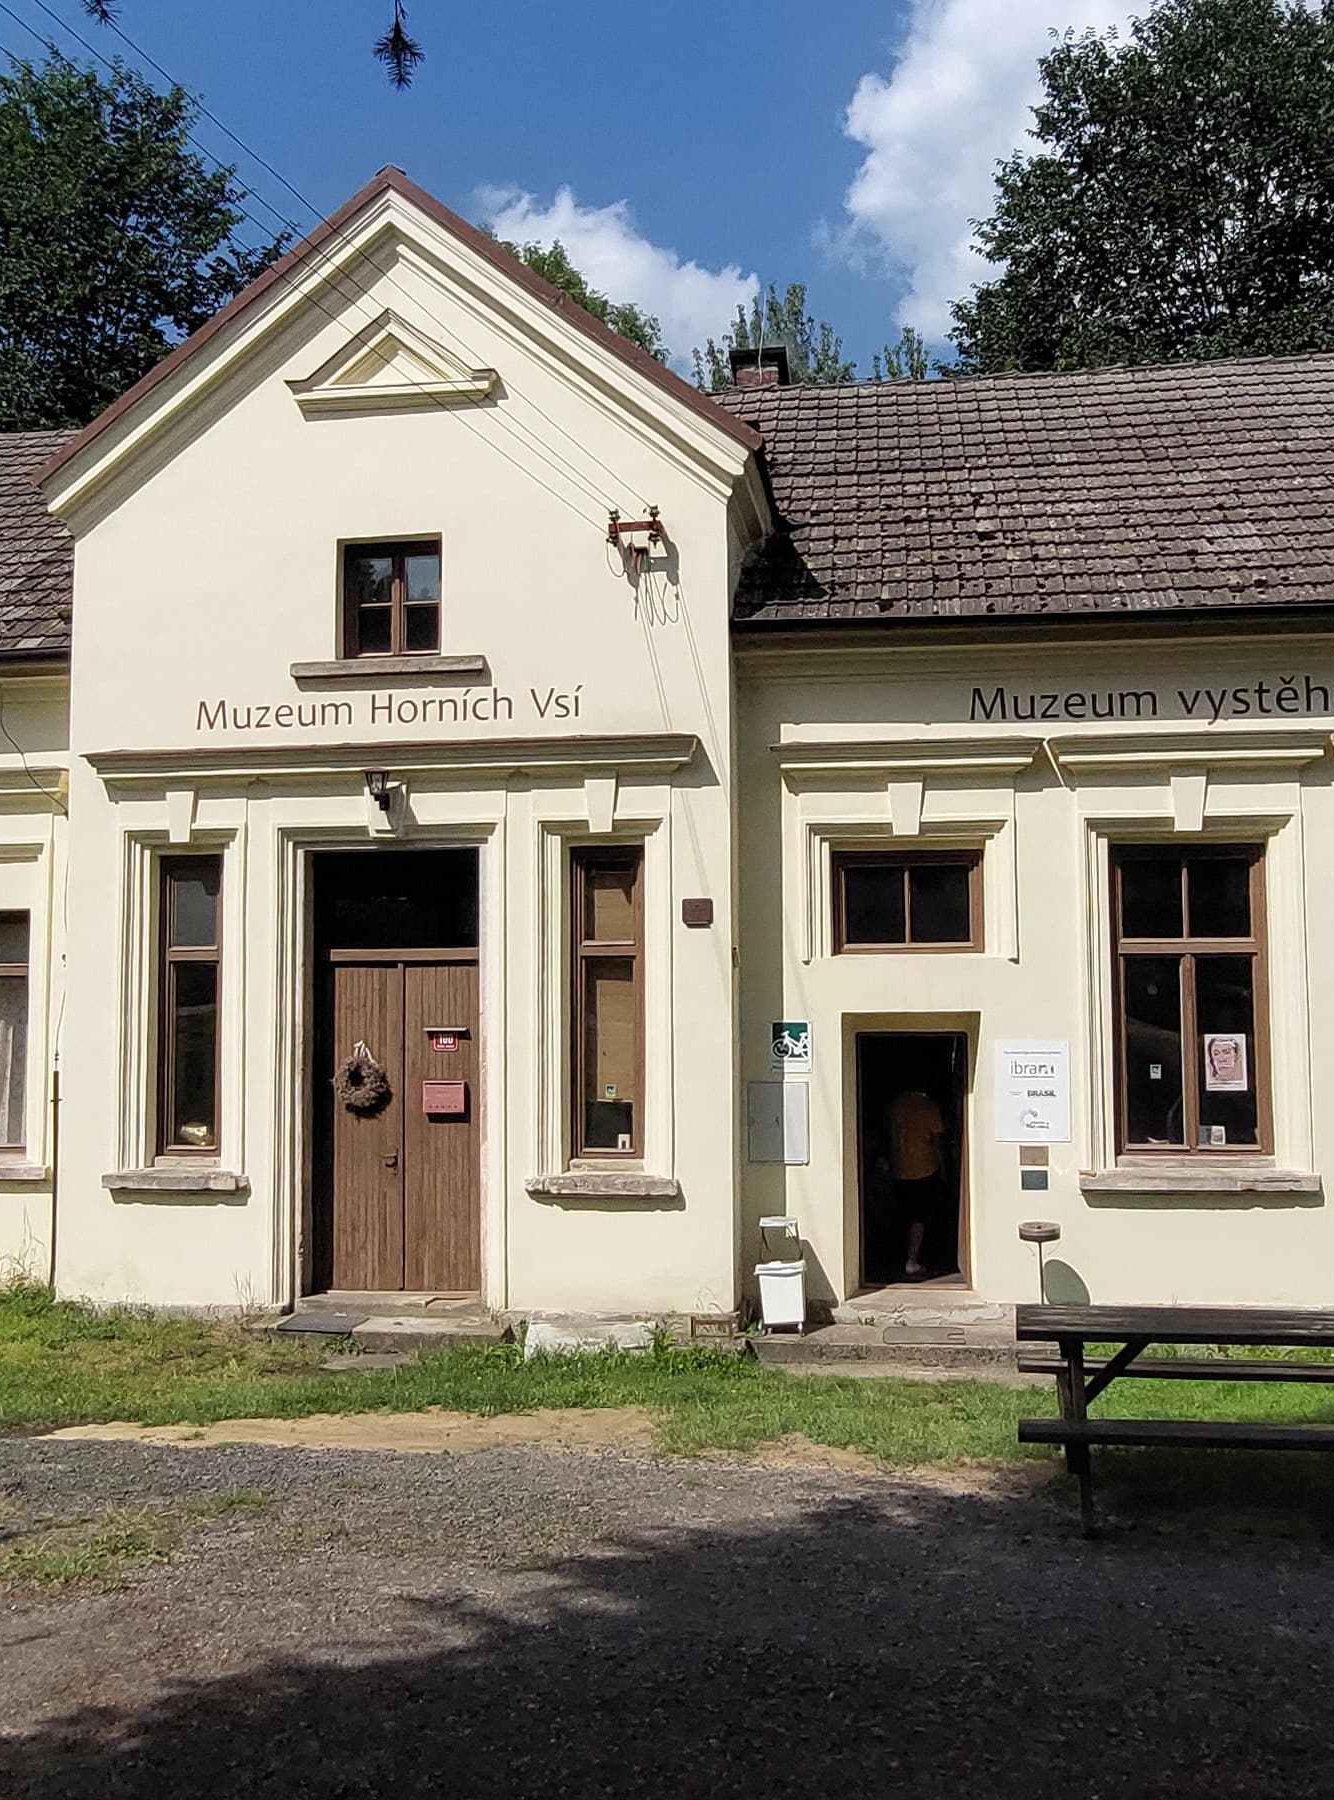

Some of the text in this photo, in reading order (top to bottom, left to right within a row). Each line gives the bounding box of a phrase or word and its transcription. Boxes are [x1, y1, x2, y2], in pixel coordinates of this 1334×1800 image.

[196, 684, 585, 731] Muzeum Horních Vsí
[969, 687, 1158, 721] Muzeum
